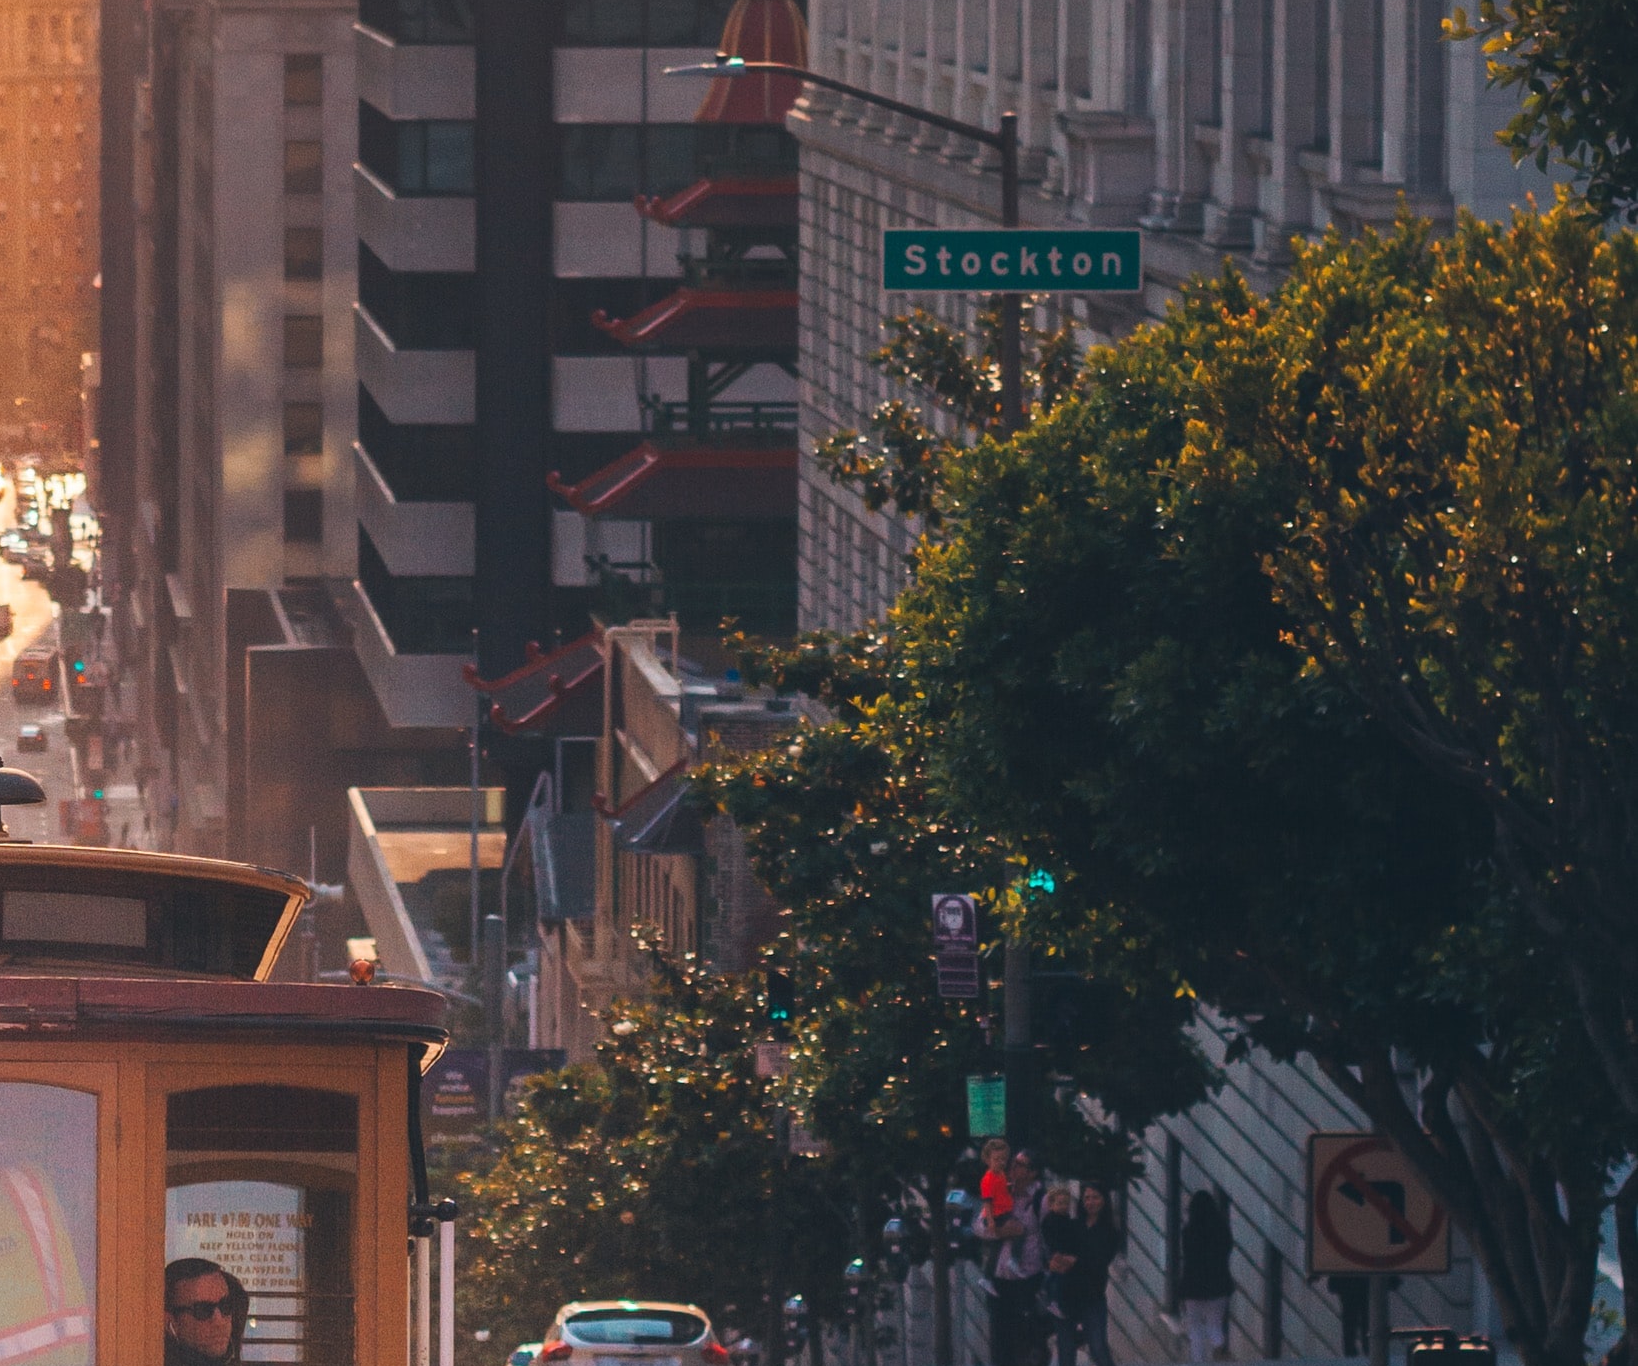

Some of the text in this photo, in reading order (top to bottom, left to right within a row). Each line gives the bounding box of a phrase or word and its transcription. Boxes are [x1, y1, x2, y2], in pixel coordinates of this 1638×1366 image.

[903, 243, 1123, 276] Stockton
[186, 1212, 217, 1228] FARE
[254, 1212, 281, 1228] ONE
[286, 1212, 314, 1228] WAY
[225, 1231, 274, 1240] HOLD ON
[199, 1242, 223, 1251] KEEP
[226, 1242, 264, 1251] YELLOW
[216, 1254, 284, 1262] AREA CLEAR
[231, 1266, 292, 1275] TRANSFERS
[252, 1278, 266, 1286] OR
